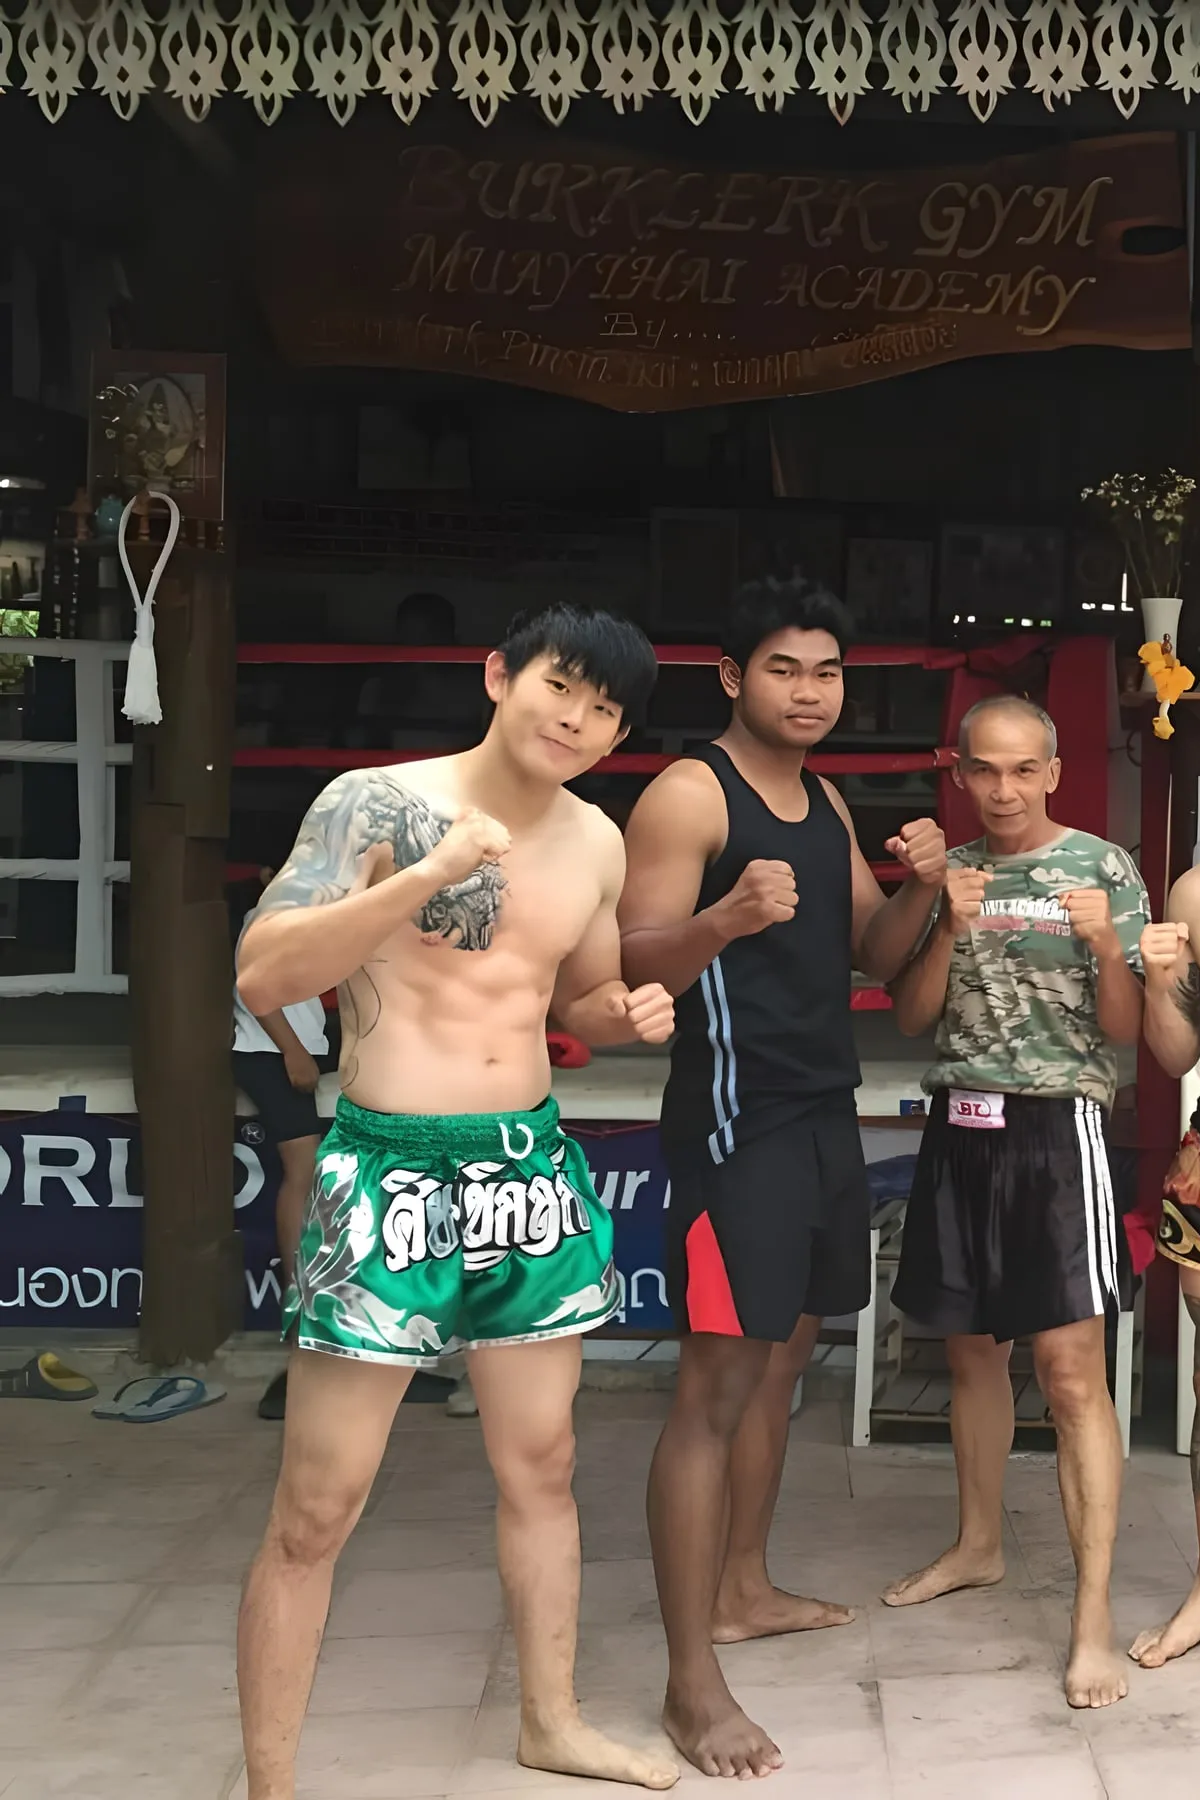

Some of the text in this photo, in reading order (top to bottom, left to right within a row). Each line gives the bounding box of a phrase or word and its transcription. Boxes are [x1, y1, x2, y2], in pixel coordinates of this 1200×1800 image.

[397, 144, 1114, 260] BURKLERK GYM
[763, 263, 1097, 337] ACADEMY
[0, 1133, 266, 1209] RL
